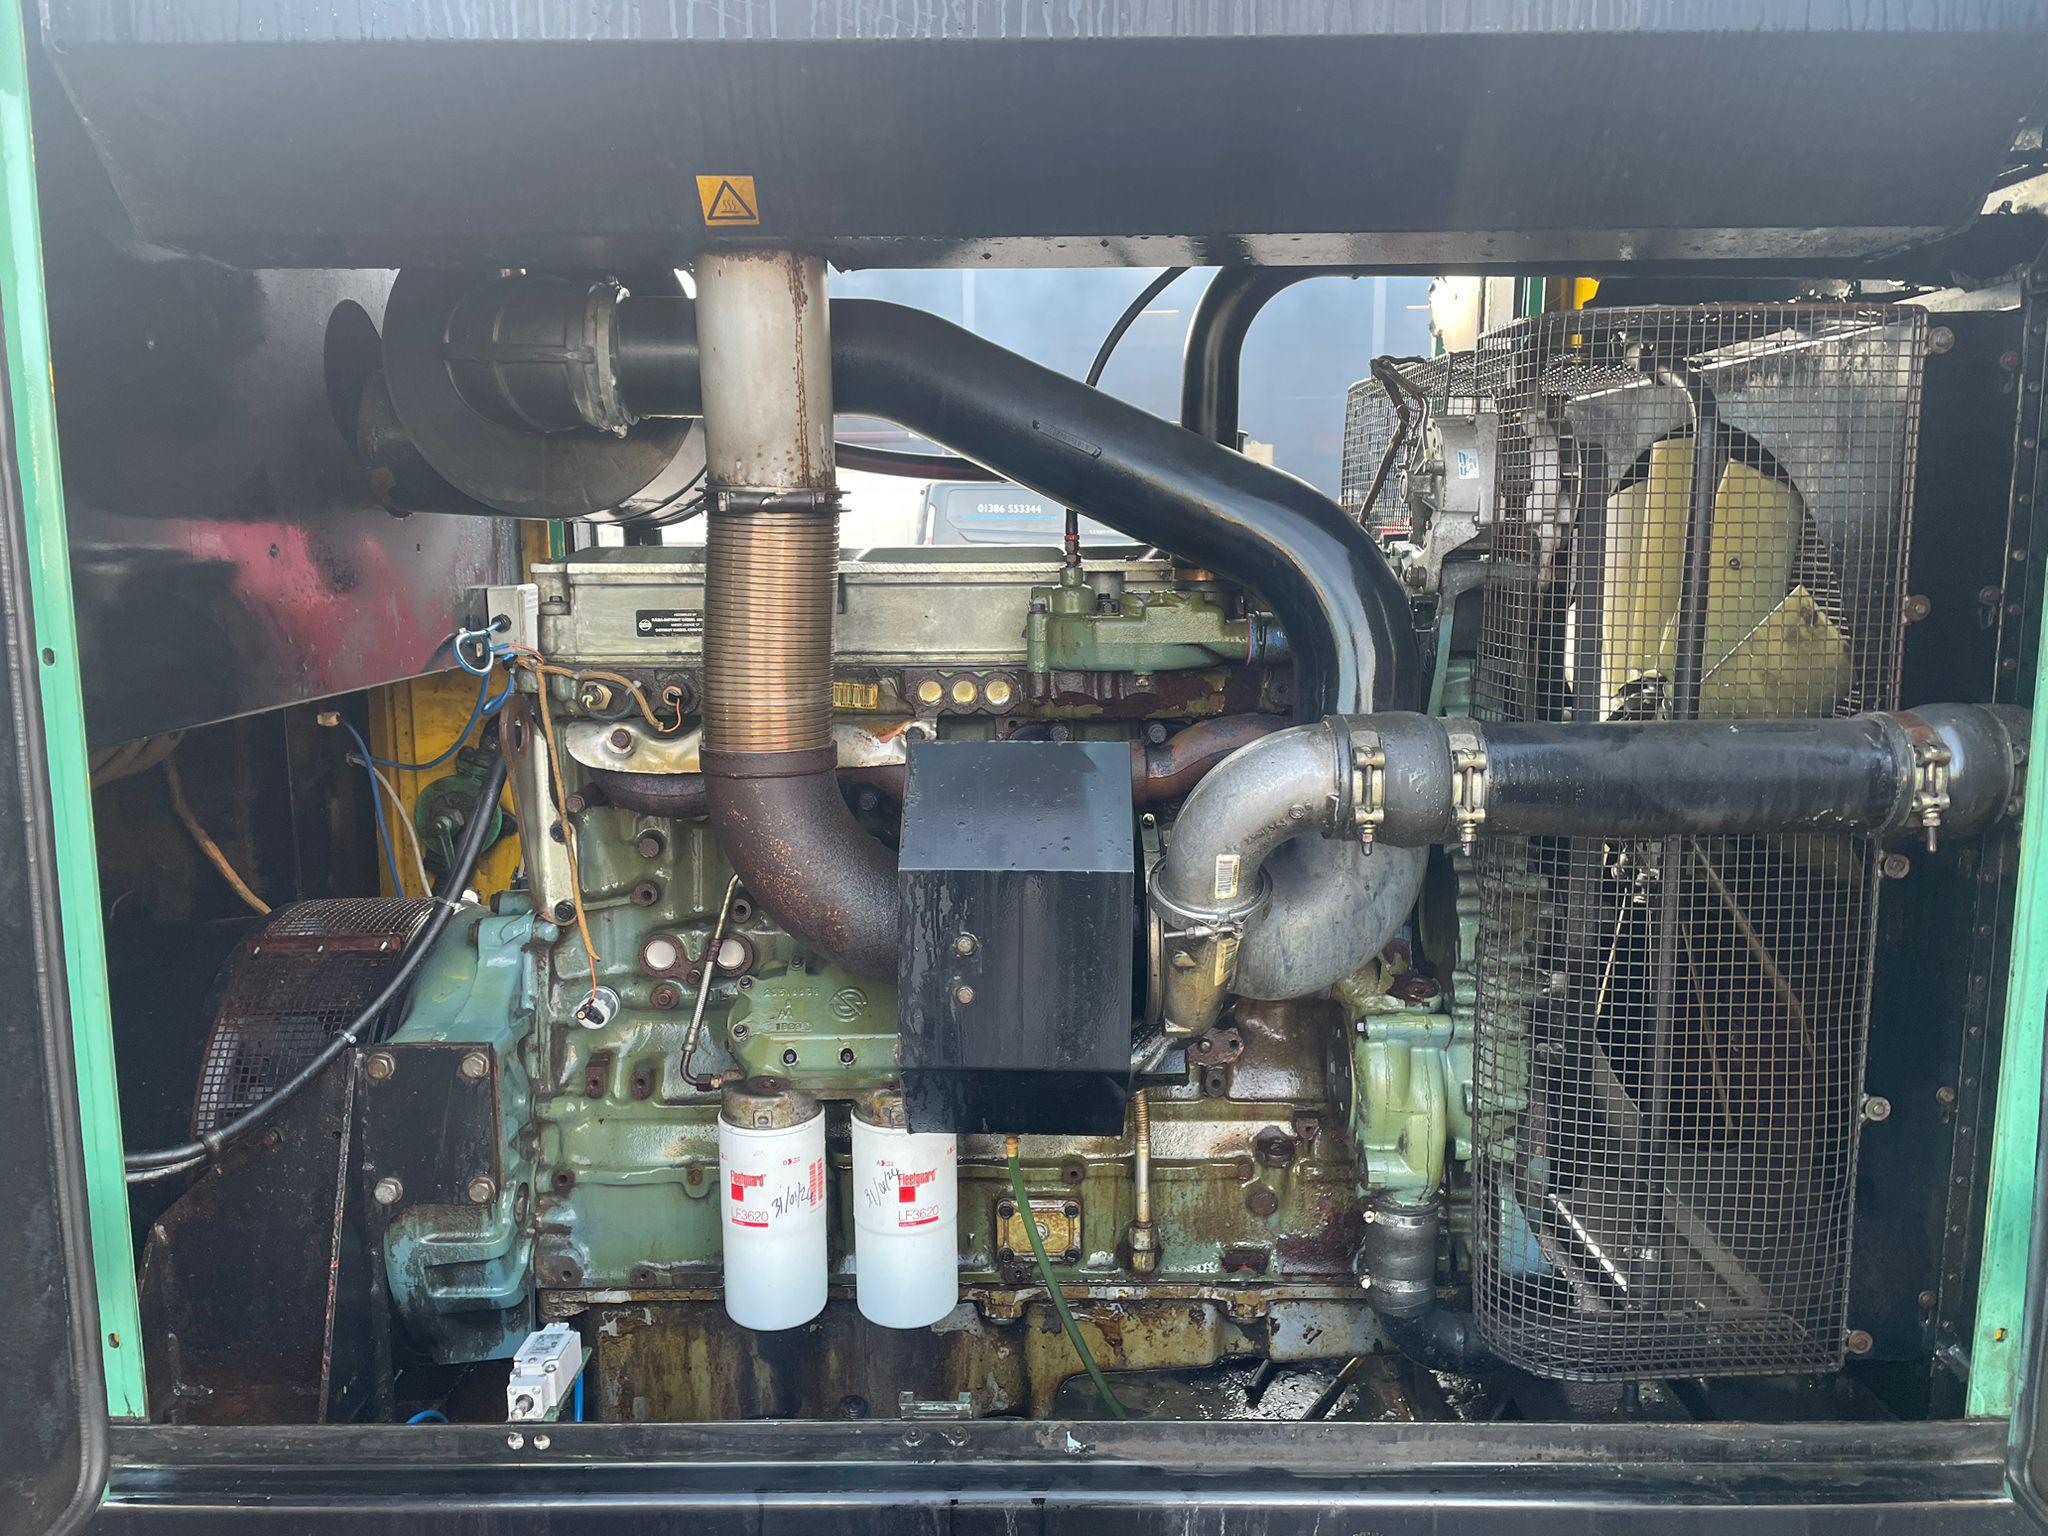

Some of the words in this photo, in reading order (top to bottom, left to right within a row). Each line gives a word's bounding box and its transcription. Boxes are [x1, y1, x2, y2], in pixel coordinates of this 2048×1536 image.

[977, 503, 1005, 514] 01386
[1007, 503, 1042, 514] 553344
[730, 1169, 764, 1188] Fleetguard
[898, 1168, 936, 1188] Fleetguard
[730, 1206, 769, 1222] LF3620
[897, 1204, 939, 1222] LF3620
